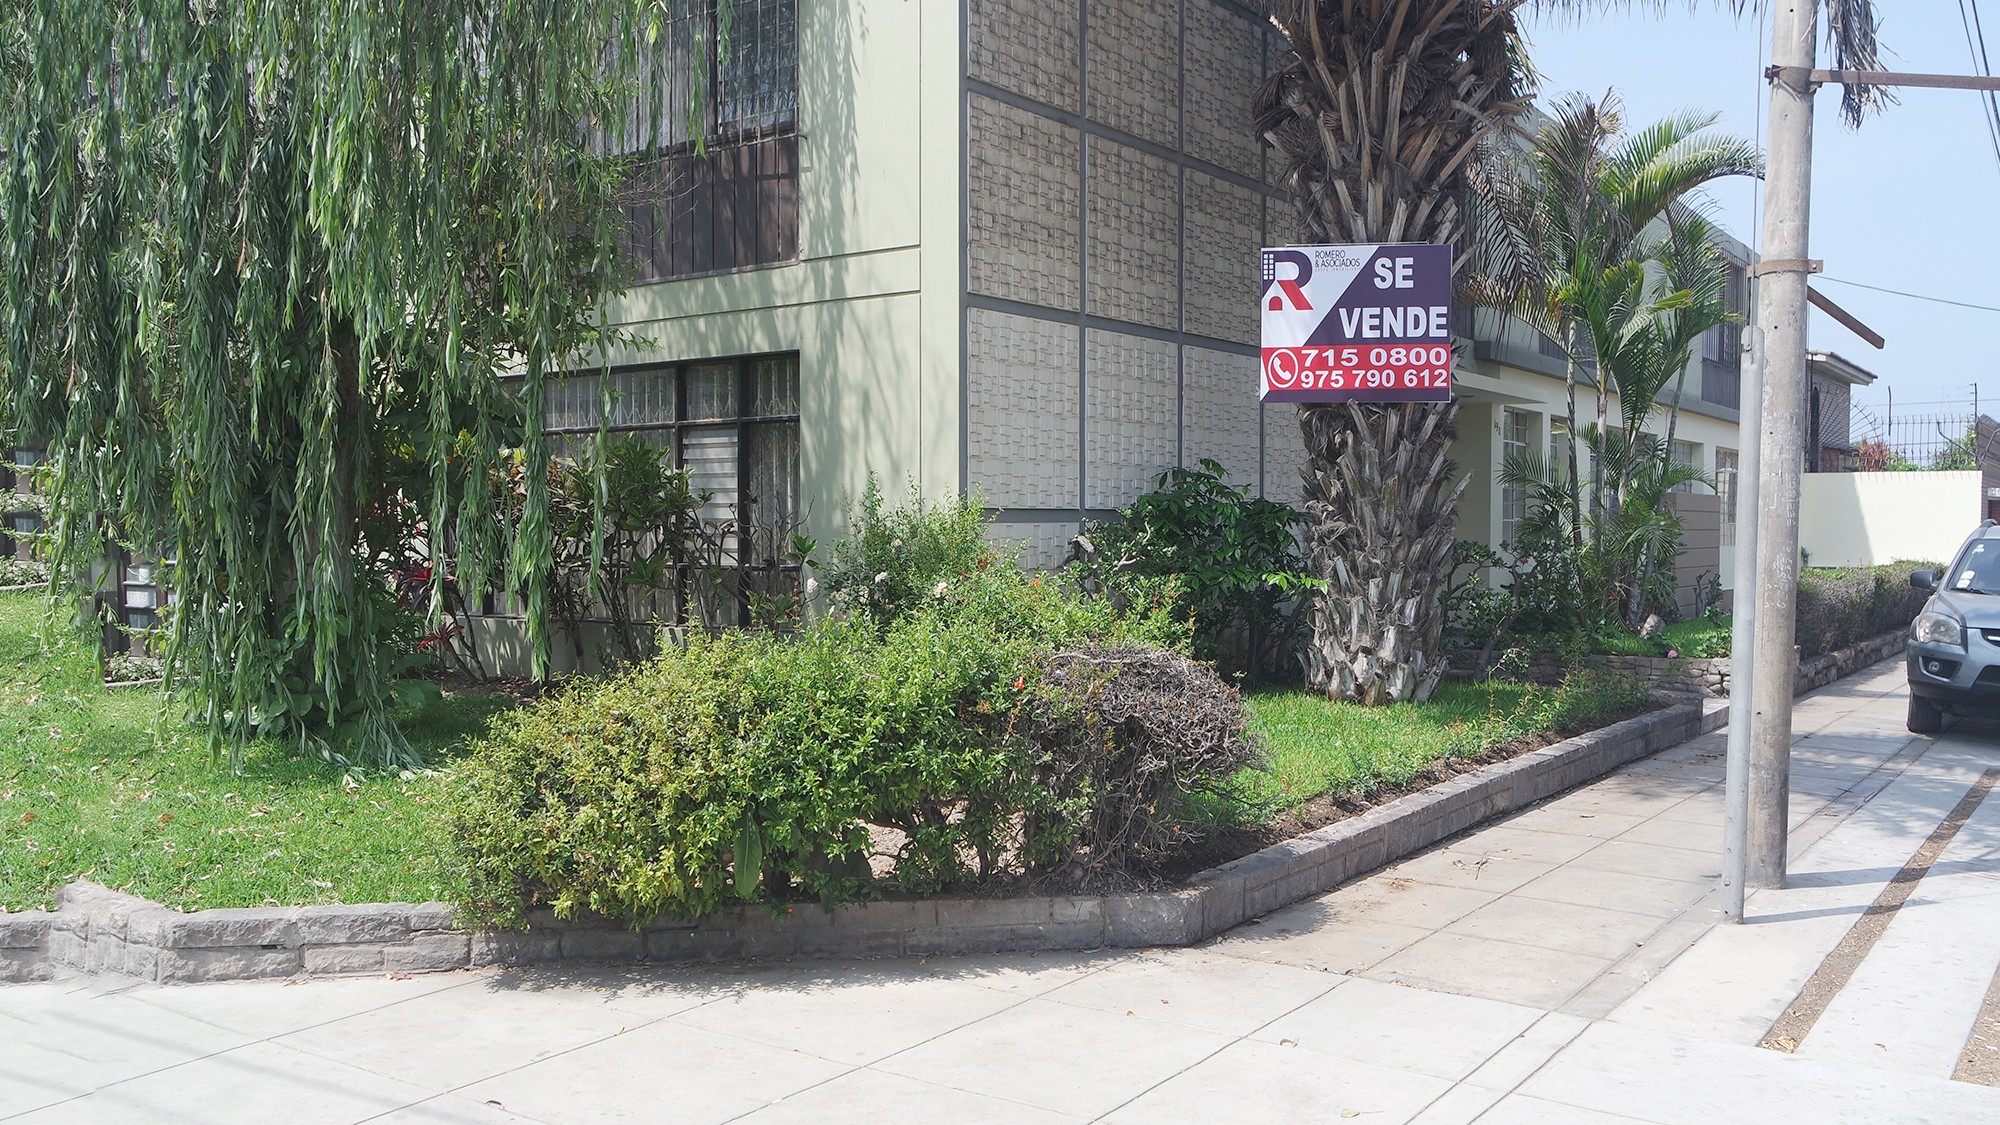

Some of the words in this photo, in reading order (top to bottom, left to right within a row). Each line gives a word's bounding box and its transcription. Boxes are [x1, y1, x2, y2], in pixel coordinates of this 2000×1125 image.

[1315, 250, 1346, 259] ROMERO
[1315, 260, 1320, 268] &
[1321, 258, 1361, 268] ASOCIADOS
[1373, 257, 1414, 289] SE
[1338, 306, 1448, 338] VENDE
[1301, 349, 1359, 367] 715
[1369, 348, 1447, 366] 0800
[1300, 370, 1344, 388] 975
[1352, 369, 1396, 387] 790
[1403, 369, 1448, 387] 612
